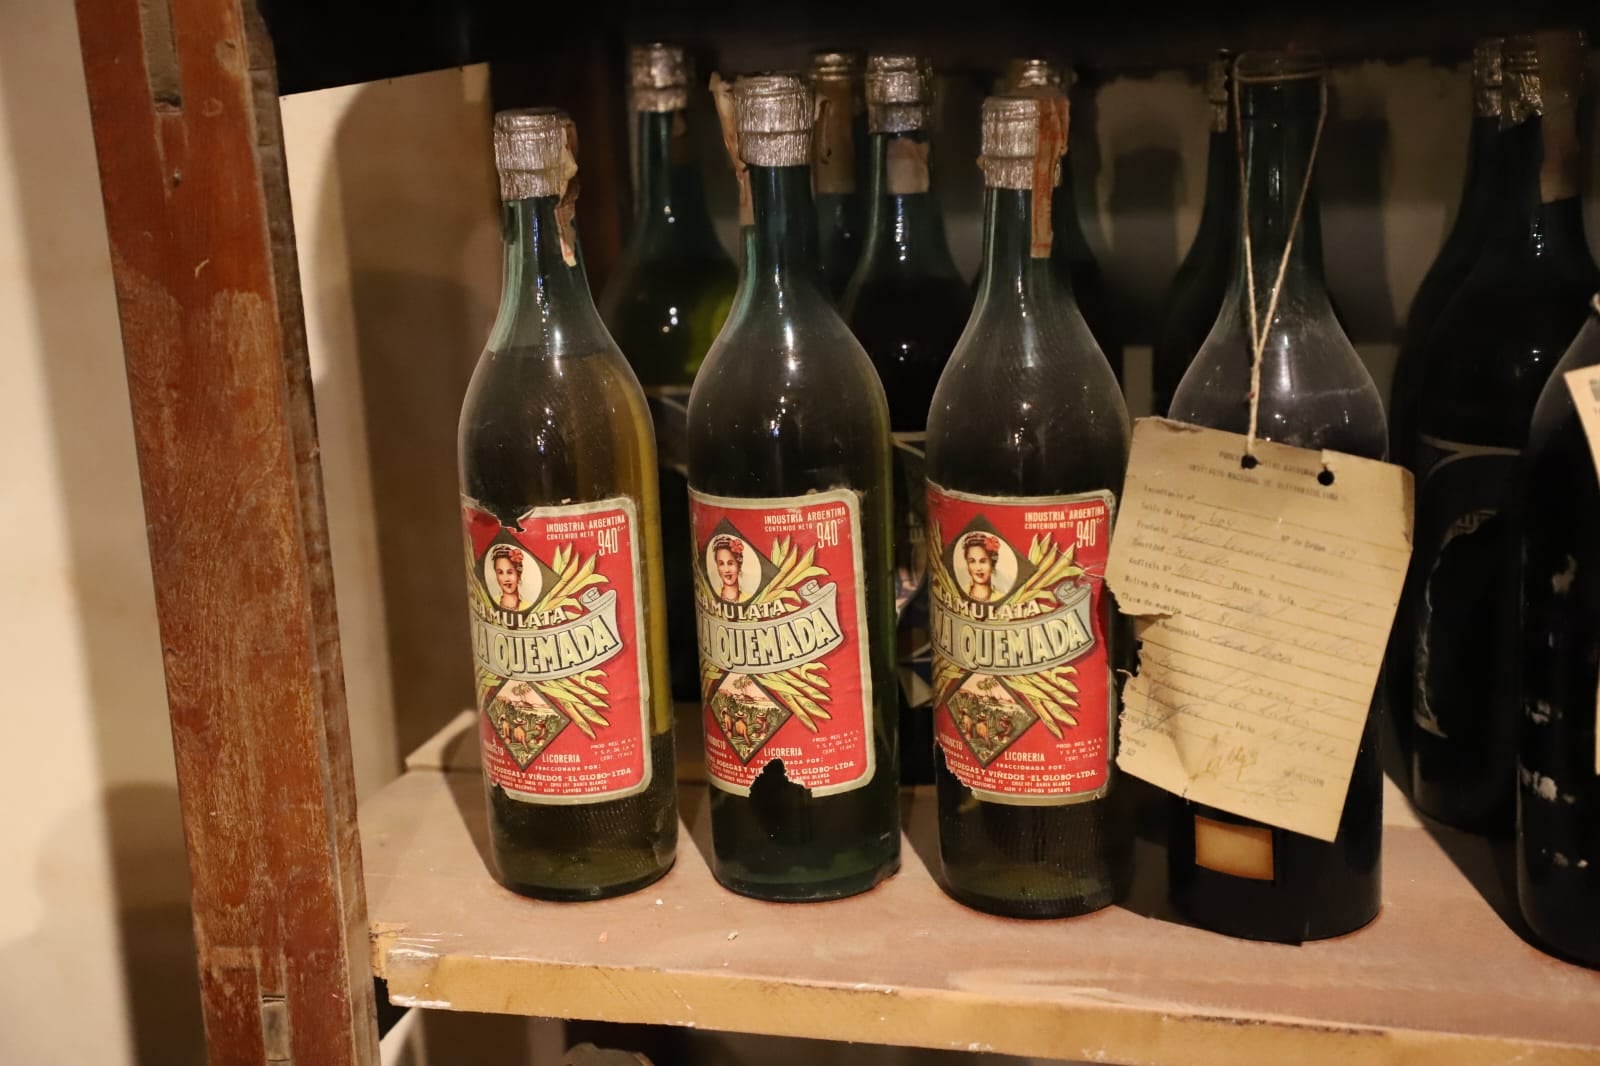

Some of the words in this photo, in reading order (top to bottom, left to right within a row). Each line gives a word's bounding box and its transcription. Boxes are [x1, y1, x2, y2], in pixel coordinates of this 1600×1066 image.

[546, 519, 585, 533] INDUSTRIA
[588, 514, 625, 529] ARGENTINA
[764, 511, 803, 525] INDUSTRIA
[807, 506, 846, 522] ARGENTINA
[1025, 511, 1065, 522] INDUSTRIA
[1069, 506, 1104, 520] ARGENTINA
[598, 528, 618, 556] 940
[816, 520, 838, 549] 940
[1076, 519, 1096, 549] 940
[490, 608, 567, 628] MULATA
[711, 600, 786, 620] MULATA
[954, 598, 1041, 620] MULATA
[494, 615, 619, 677] QUEMADA
[716, 608, 840, 670] QUEMADA
[960, 608, 1092, 670] QUEMADA
[542, 754, 581, 764] LICORERIA
[764, 748, 802, 758] LICORERIA
[1004, 751, 1045, 762] LICORERIA
